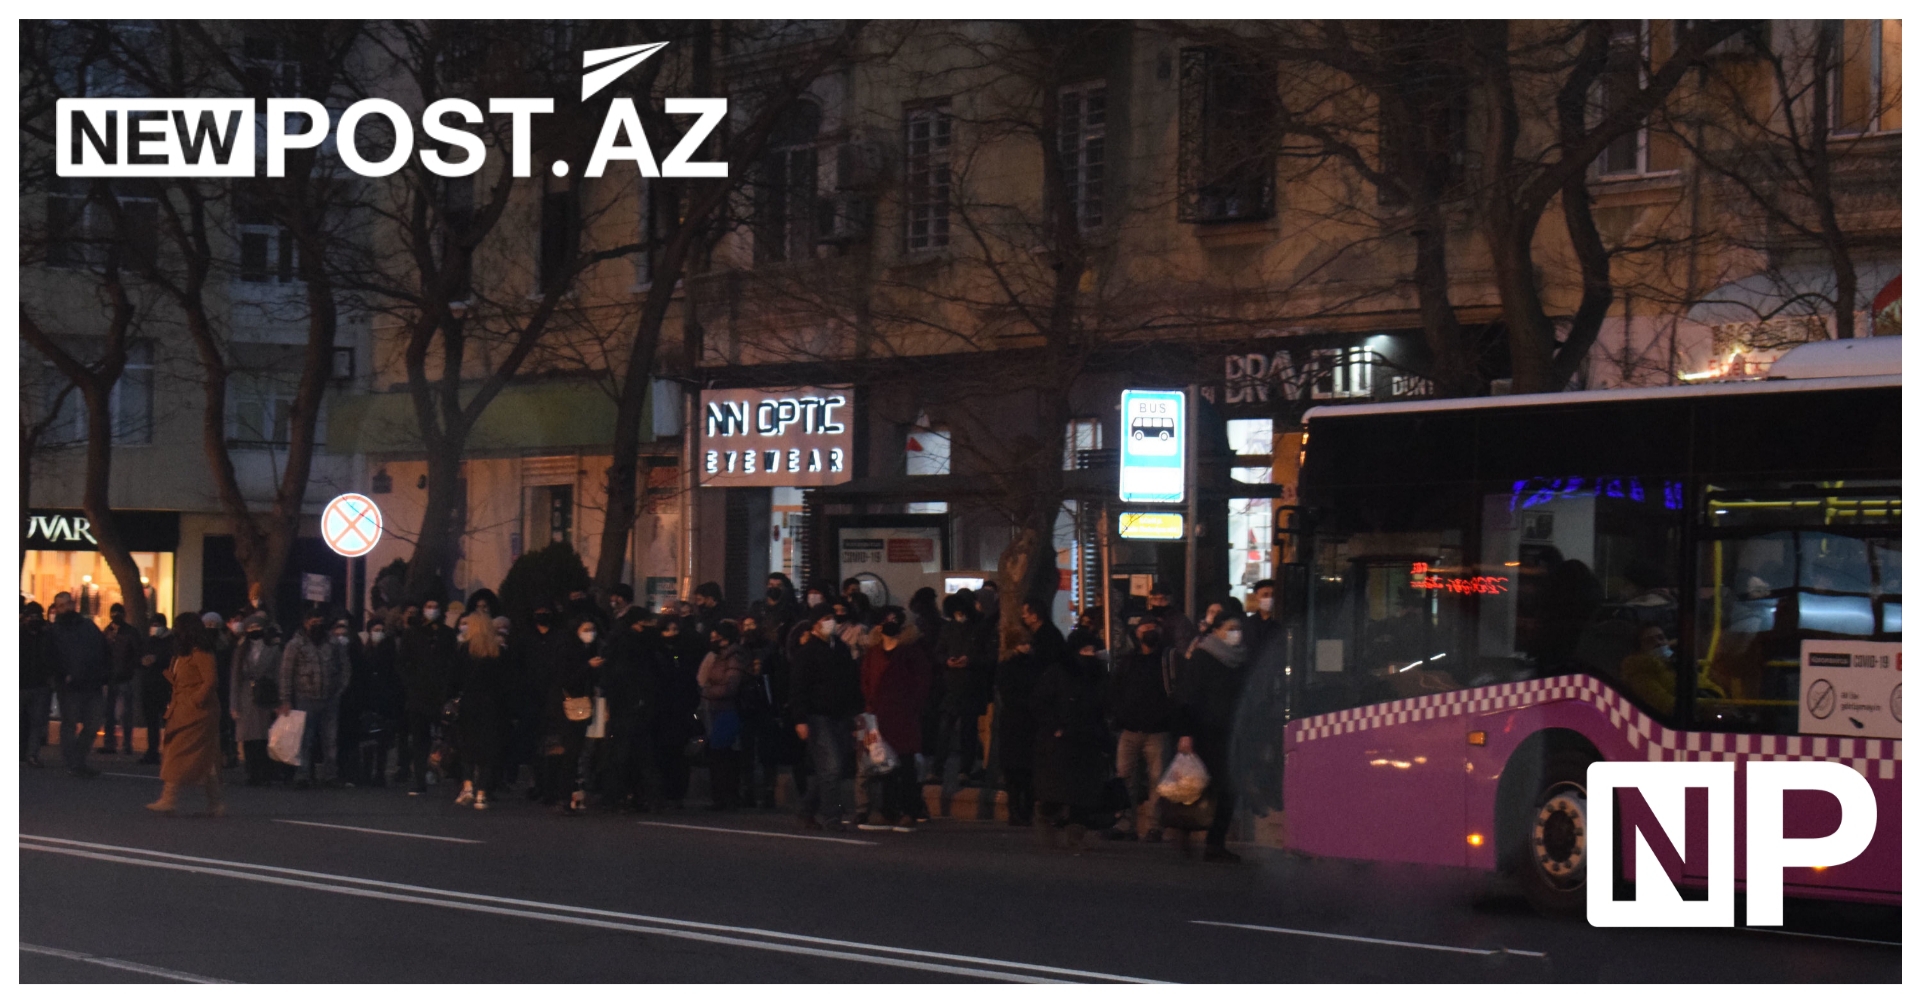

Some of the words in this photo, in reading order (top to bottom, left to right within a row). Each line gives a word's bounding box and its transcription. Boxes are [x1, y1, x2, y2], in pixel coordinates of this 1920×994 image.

[756, 395, 847, 437] OPTIC
[1139, 402, 1167, 414] BUS
[705, 448, 844, 474] EYEWEAR
[1854, 655, 1889, 668] COVID-19
